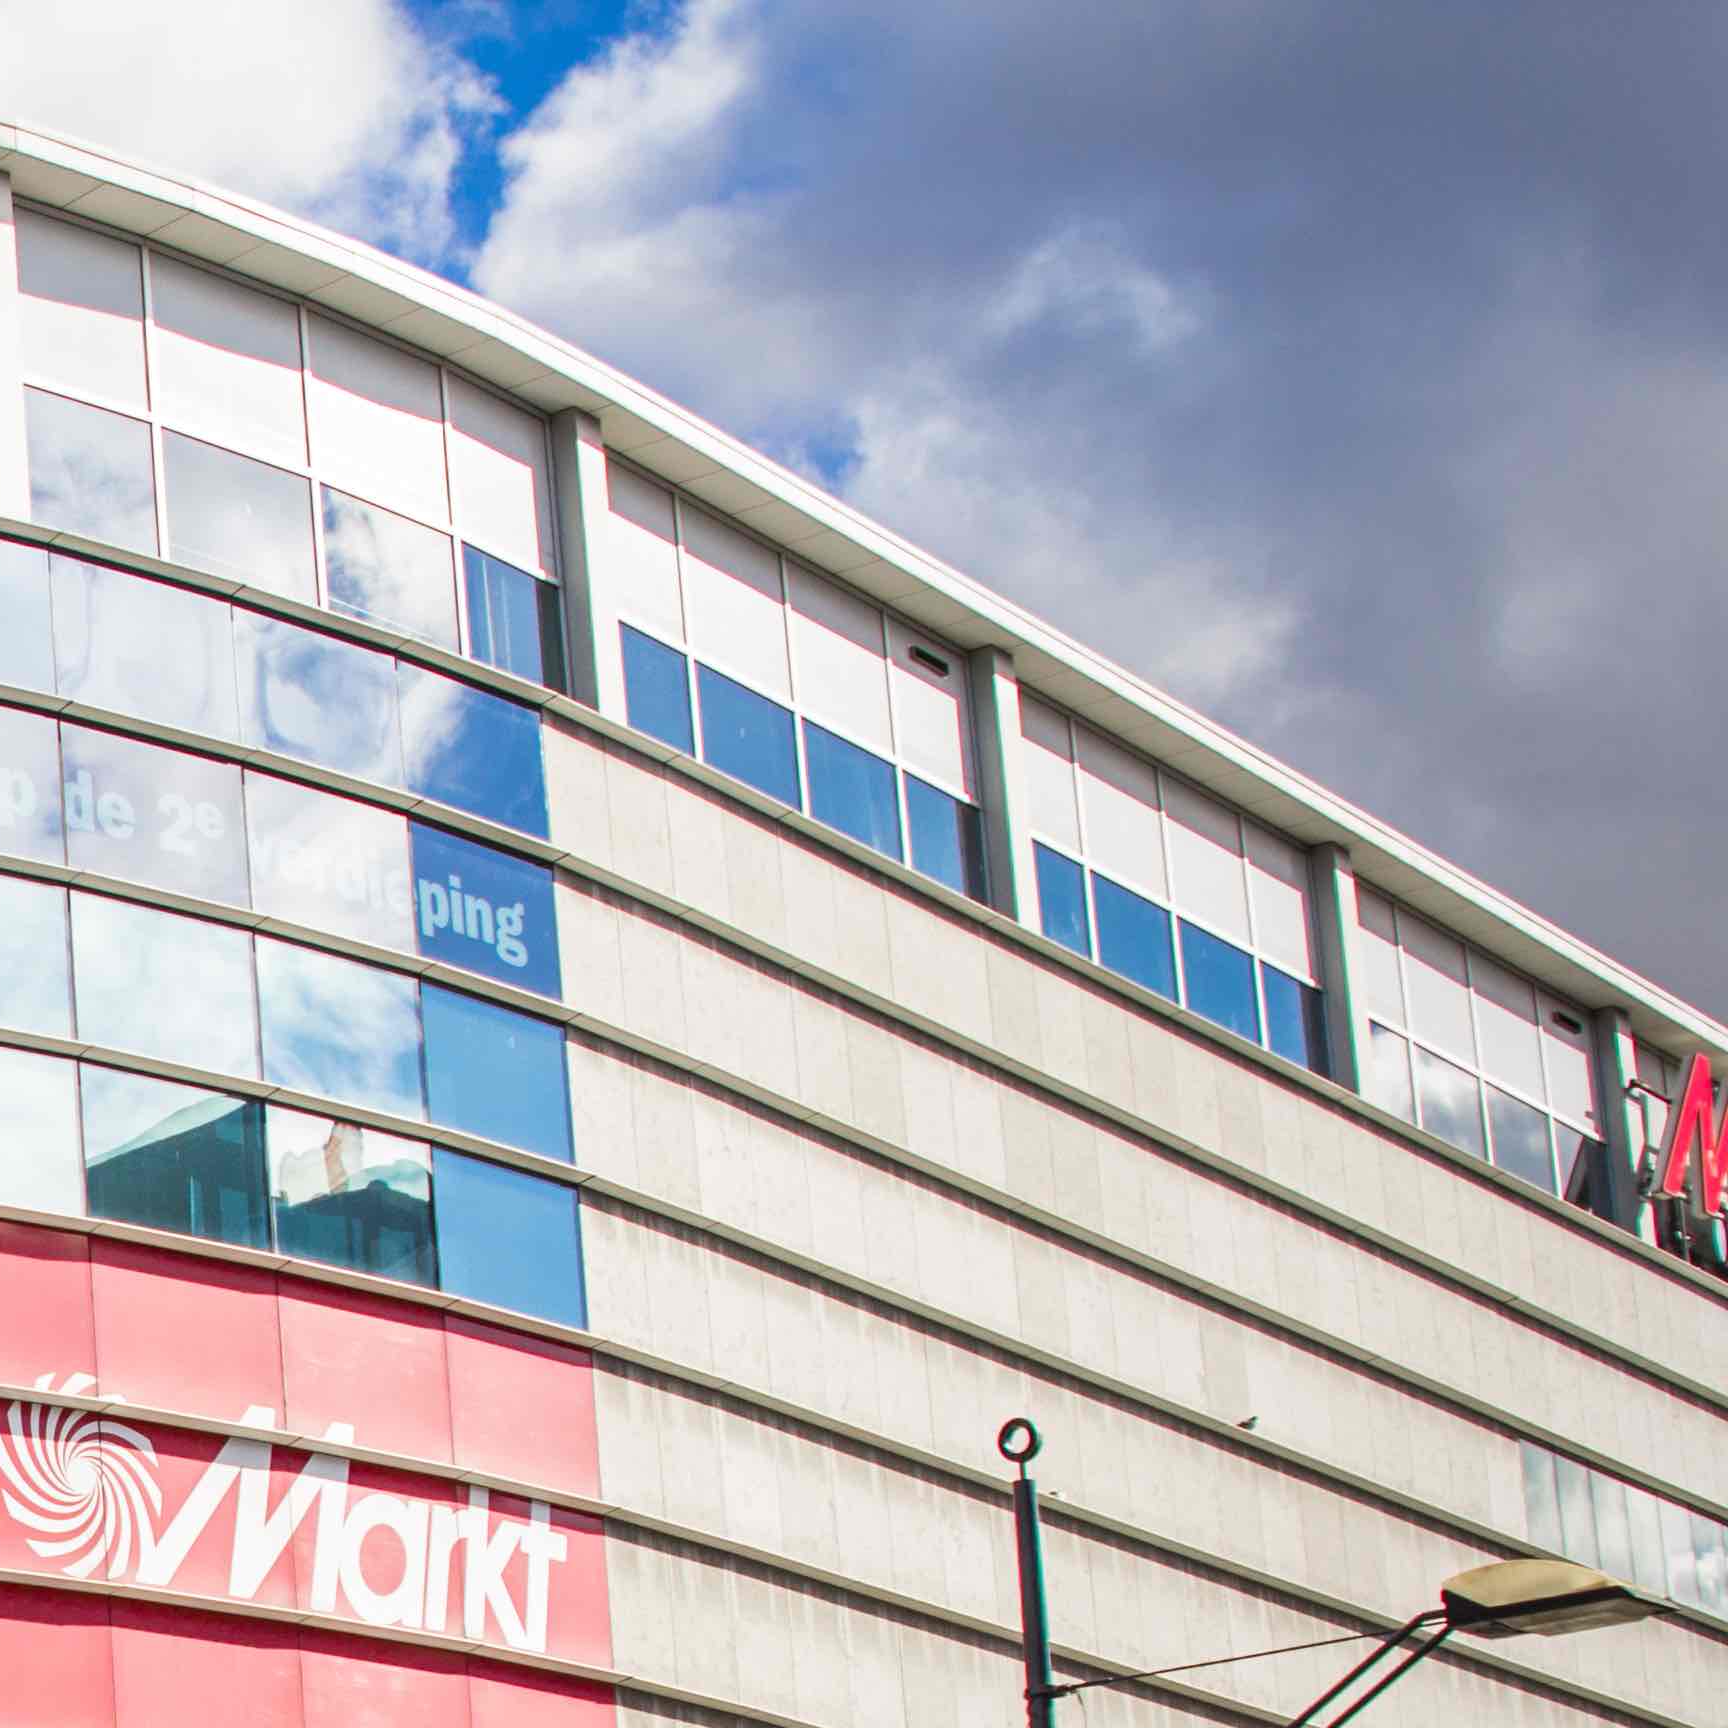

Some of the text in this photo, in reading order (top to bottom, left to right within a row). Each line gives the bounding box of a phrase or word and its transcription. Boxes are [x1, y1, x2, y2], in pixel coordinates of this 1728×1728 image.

[64, 770, 137, 840] de
[157, 794, 226, 855] 2e
[136, 1404, 566, 1655] Markt
